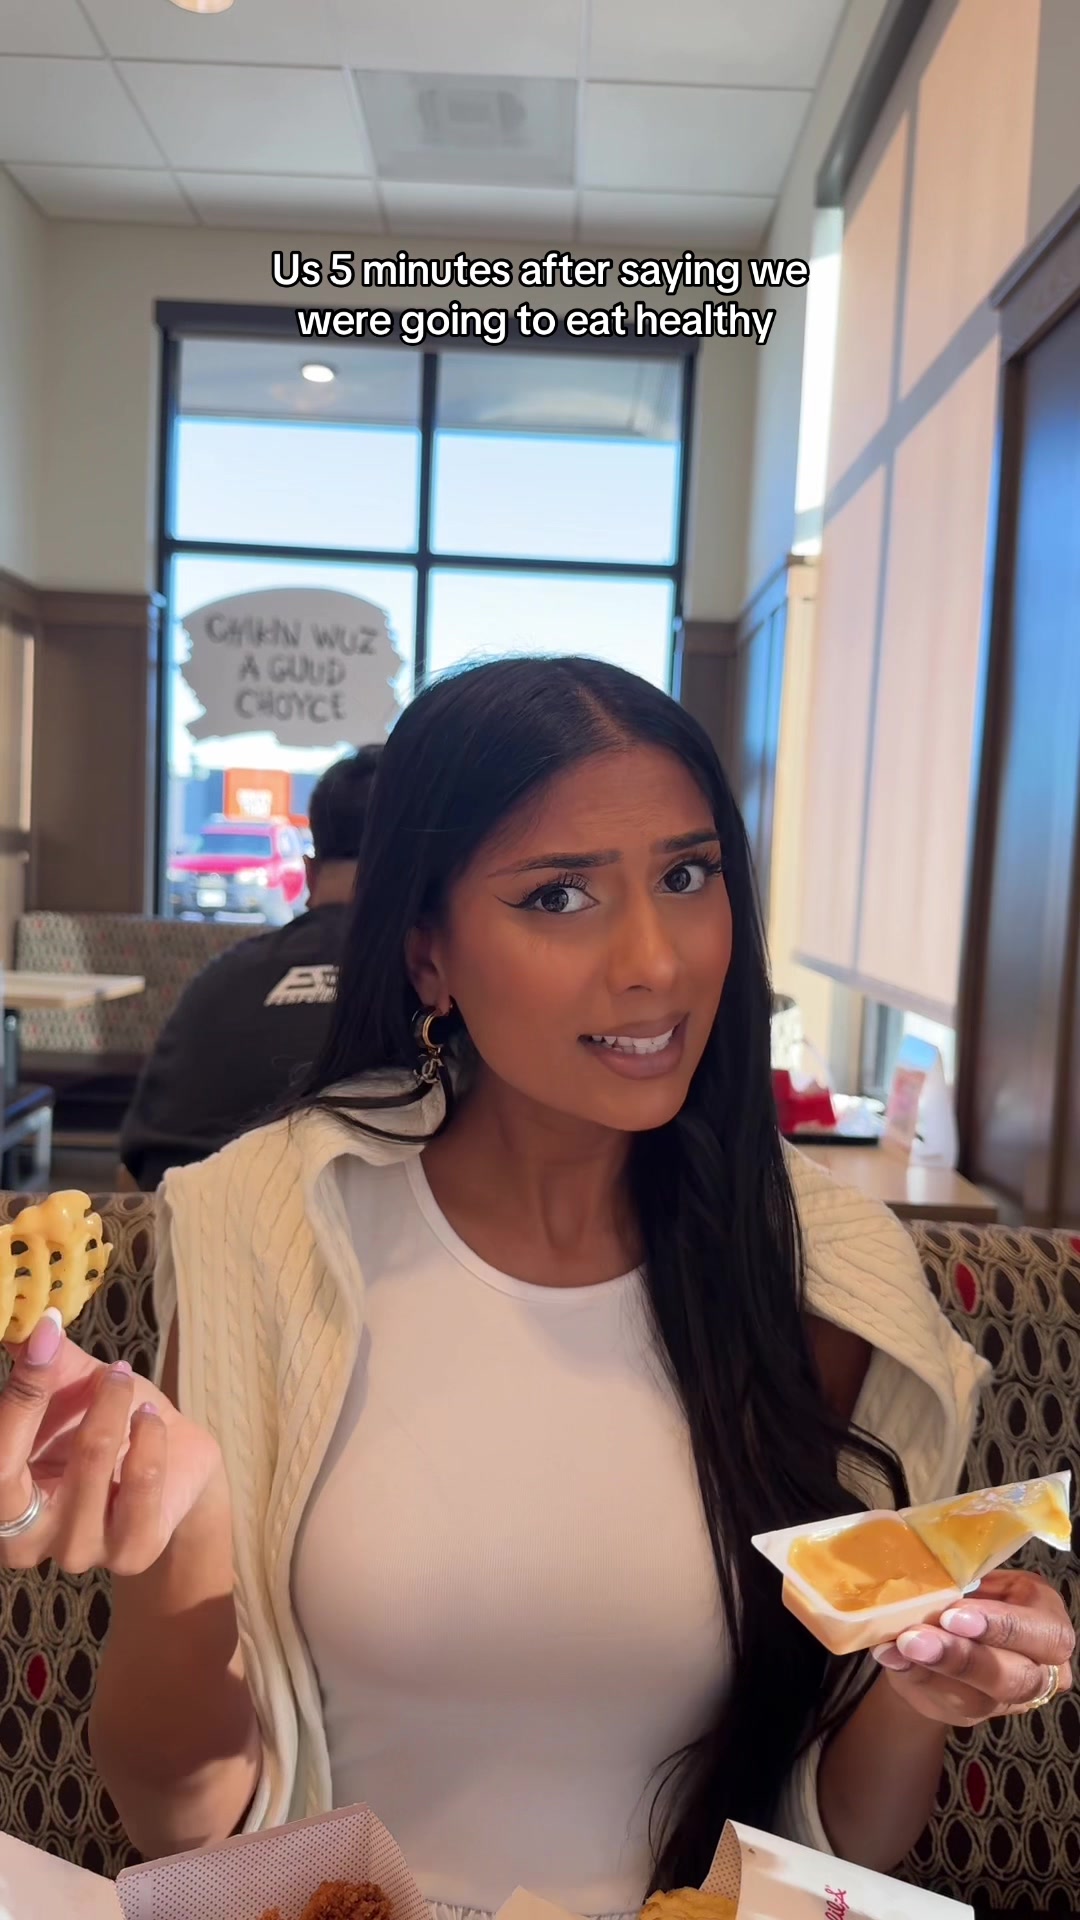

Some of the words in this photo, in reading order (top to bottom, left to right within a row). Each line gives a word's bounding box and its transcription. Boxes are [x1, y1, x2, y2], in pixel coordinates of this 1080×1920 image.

[312, 624, 378, 655] WUZ
[240, 654, 260, 681] A
[236, 690, 347, 723] CHOYCE
